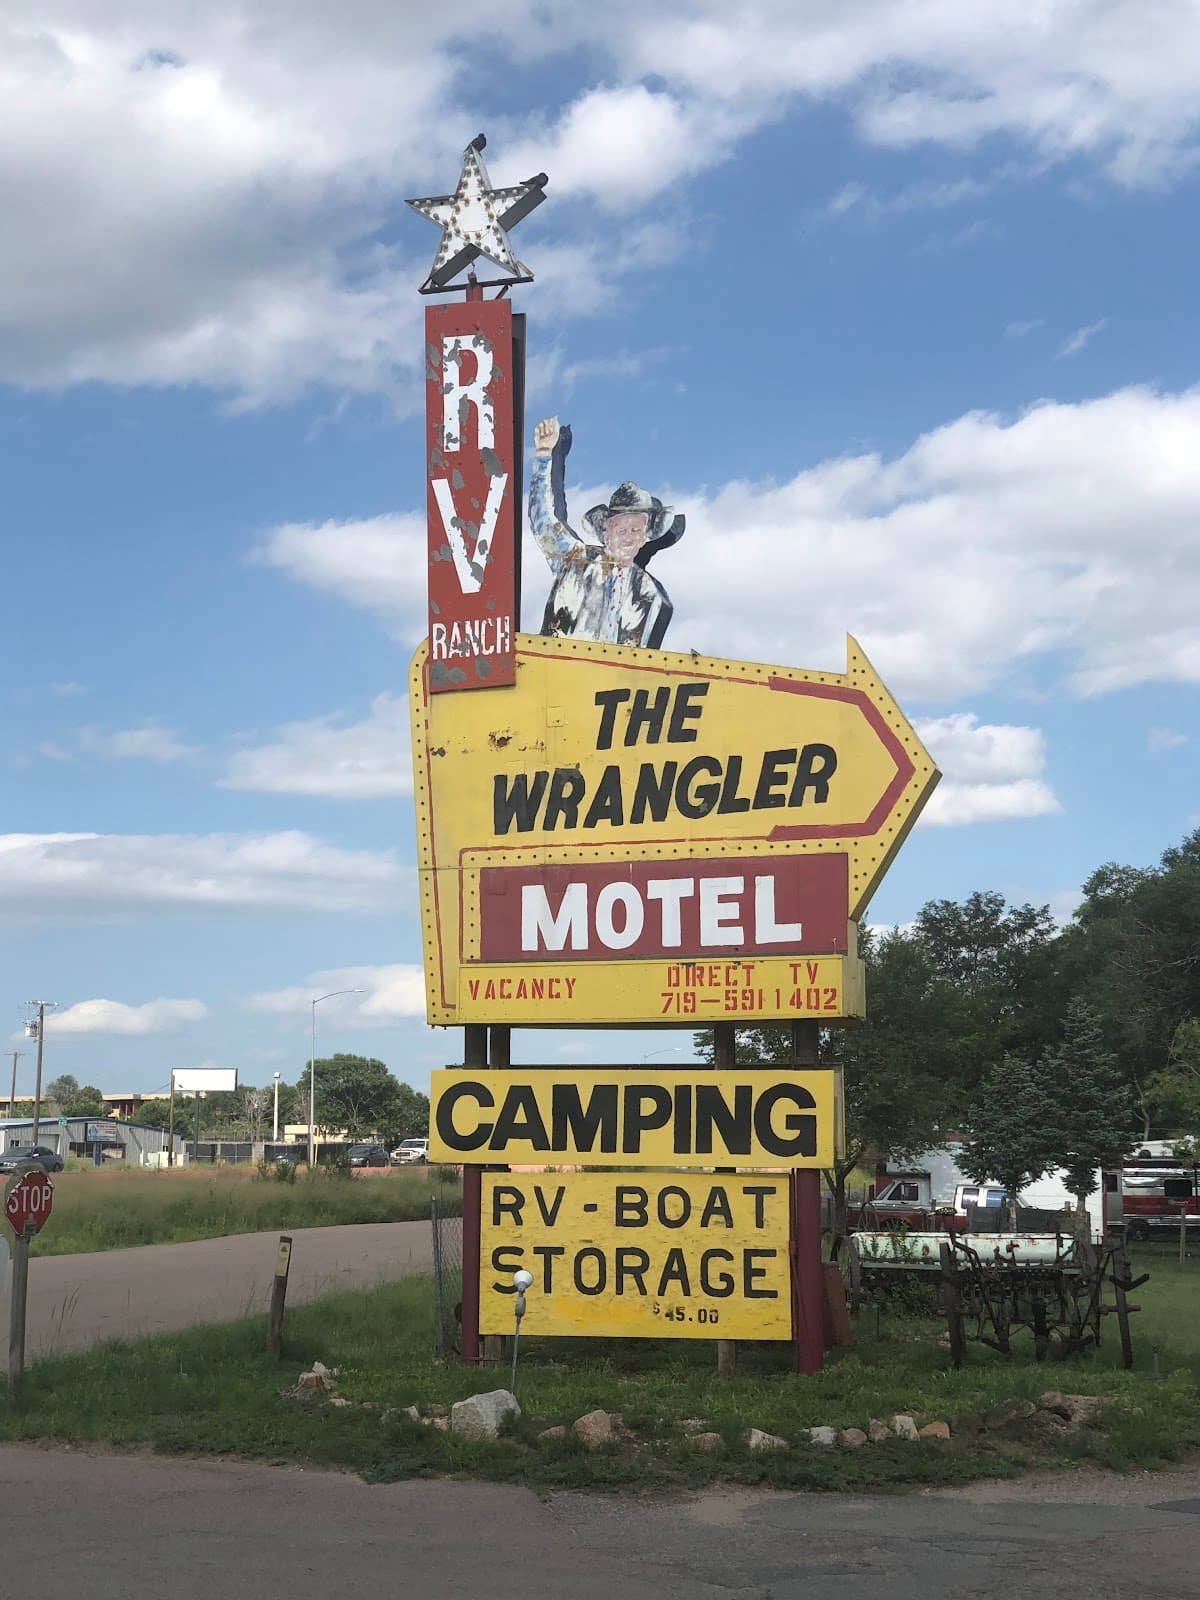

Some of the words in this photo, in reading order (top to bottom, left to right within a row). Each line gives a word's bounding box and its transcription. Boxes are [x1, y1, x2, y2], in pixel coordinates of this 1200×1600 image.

[432, 616, 511, 660] RANCH
[594, 682, 710, 750] THE
[493, 743, 837, 835] WRANGLER
[520, 875, 802, 952] MOTEL
[468, 977, 577, 1001] VACANCY
[667, 964, 755, 988] DIRECT
[789, 960, 819, 985] TV
[435, 1081, 817, 1158] CAMPING
[8, 1185, 51, 1214] STOP
[615, 1186, 777, 1229] BOAT
[491, 1246, 779, 1299] STORAGE
